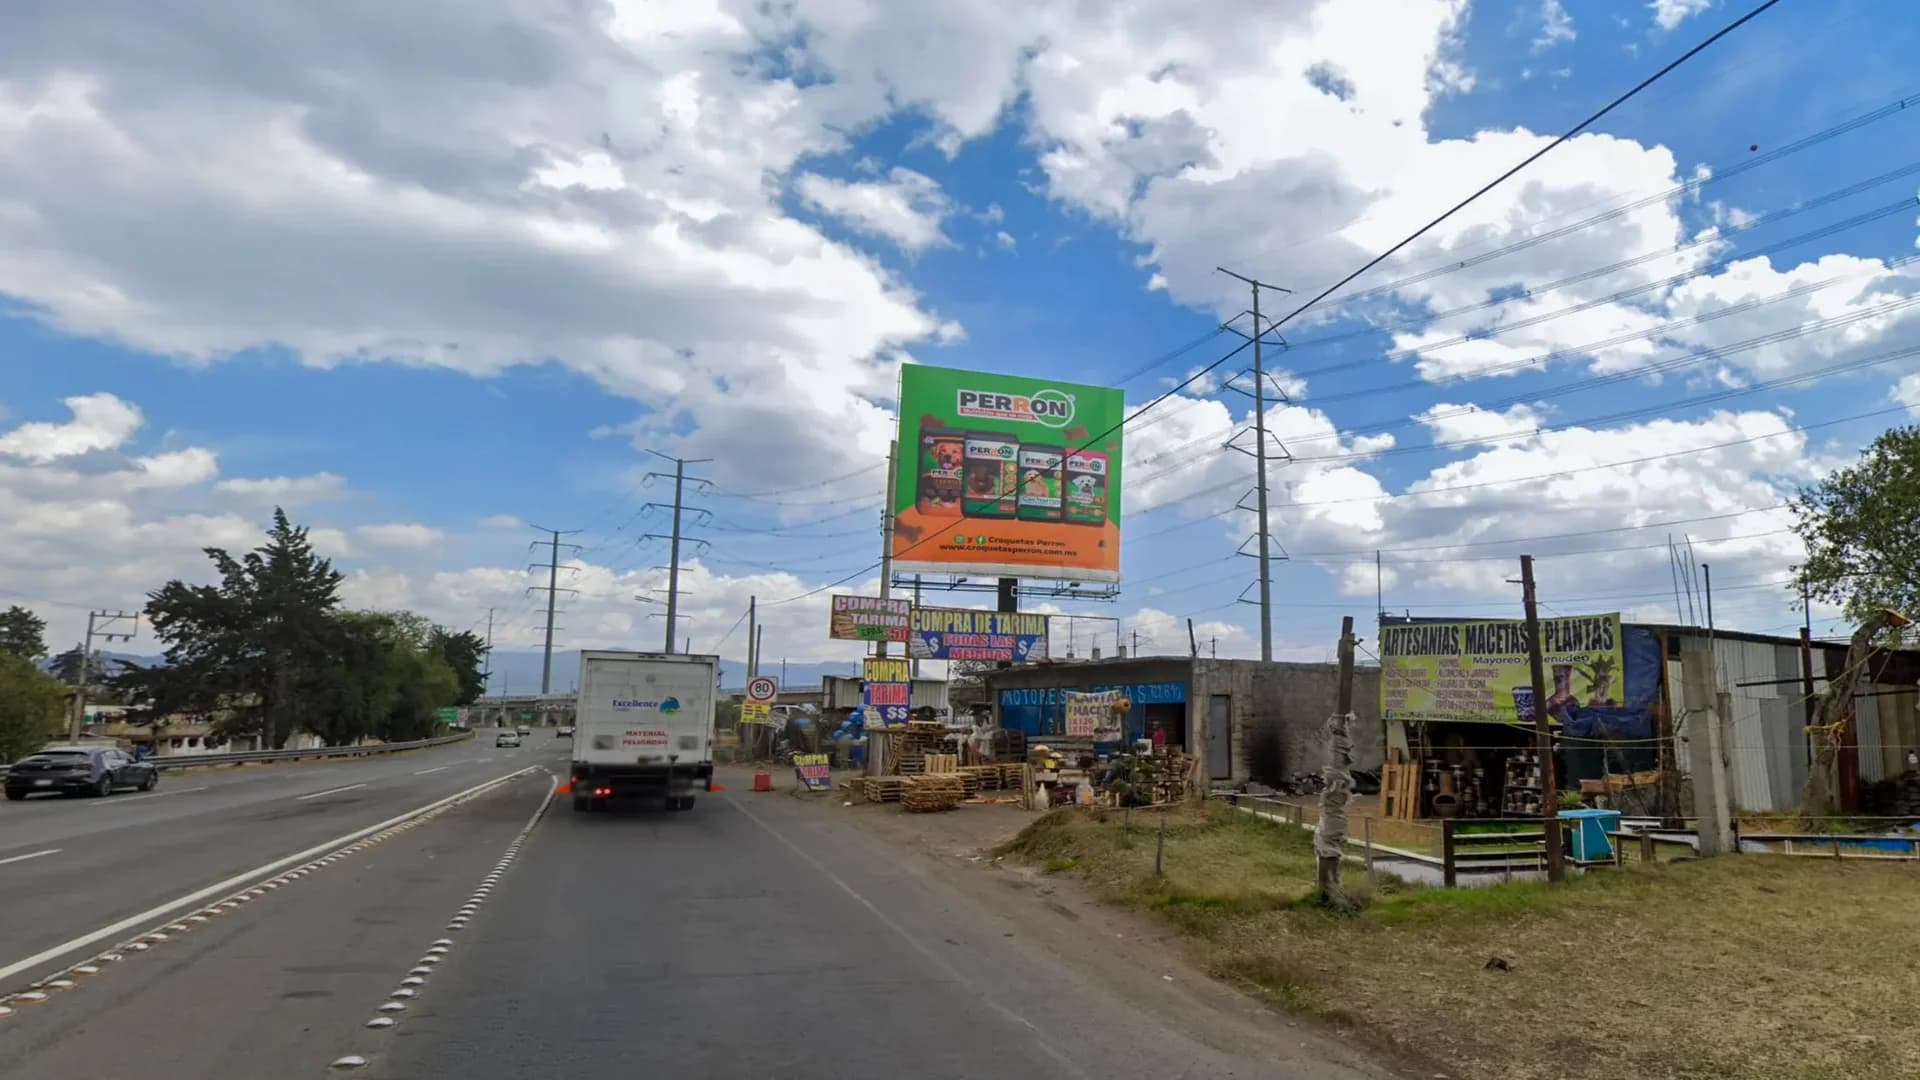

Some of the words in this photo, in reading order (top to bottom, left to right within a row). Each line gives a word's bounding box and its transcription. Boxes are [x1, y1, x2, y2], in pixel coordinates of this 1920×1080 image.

[960, 391, 1066, 416] PERRON
[939, 543, 1078, 557] www.croquetasperron.com.mx
[988, 536, 1034, 547] Croquetas
[1037, 539, 1066, 547] Perron
[834, 596, 910, 615] COMPRA
[851, 613, 909, 626] TARIMA
[911, 610, 975, 633] COMPRA
[975, 612, 993, 634] DE
[995, 614, 1047, 636] TARIMA
[929, 636, 939, 653] $
[1018, 639, 1028, 655] $
[1384, 625, 1462, 656] ARTESANIAS,
[1465, 622, 1529, 655] MACETAS
[1545, 617, 1614, 652] PLANTAS
[1473, 655, 1521, 666] Mayoreo
[1542, 655, 1590, 663] enudeo
[864, 660, 910, 682] COMPRA
[755, 682, 769, 693] 80
[870, 683, 908, 704] TARIMA
[1002, 687, 1065, 706] MOTORES
[612, 699, 658, 708] Excellence
[887, 706, 908, 721] $$
